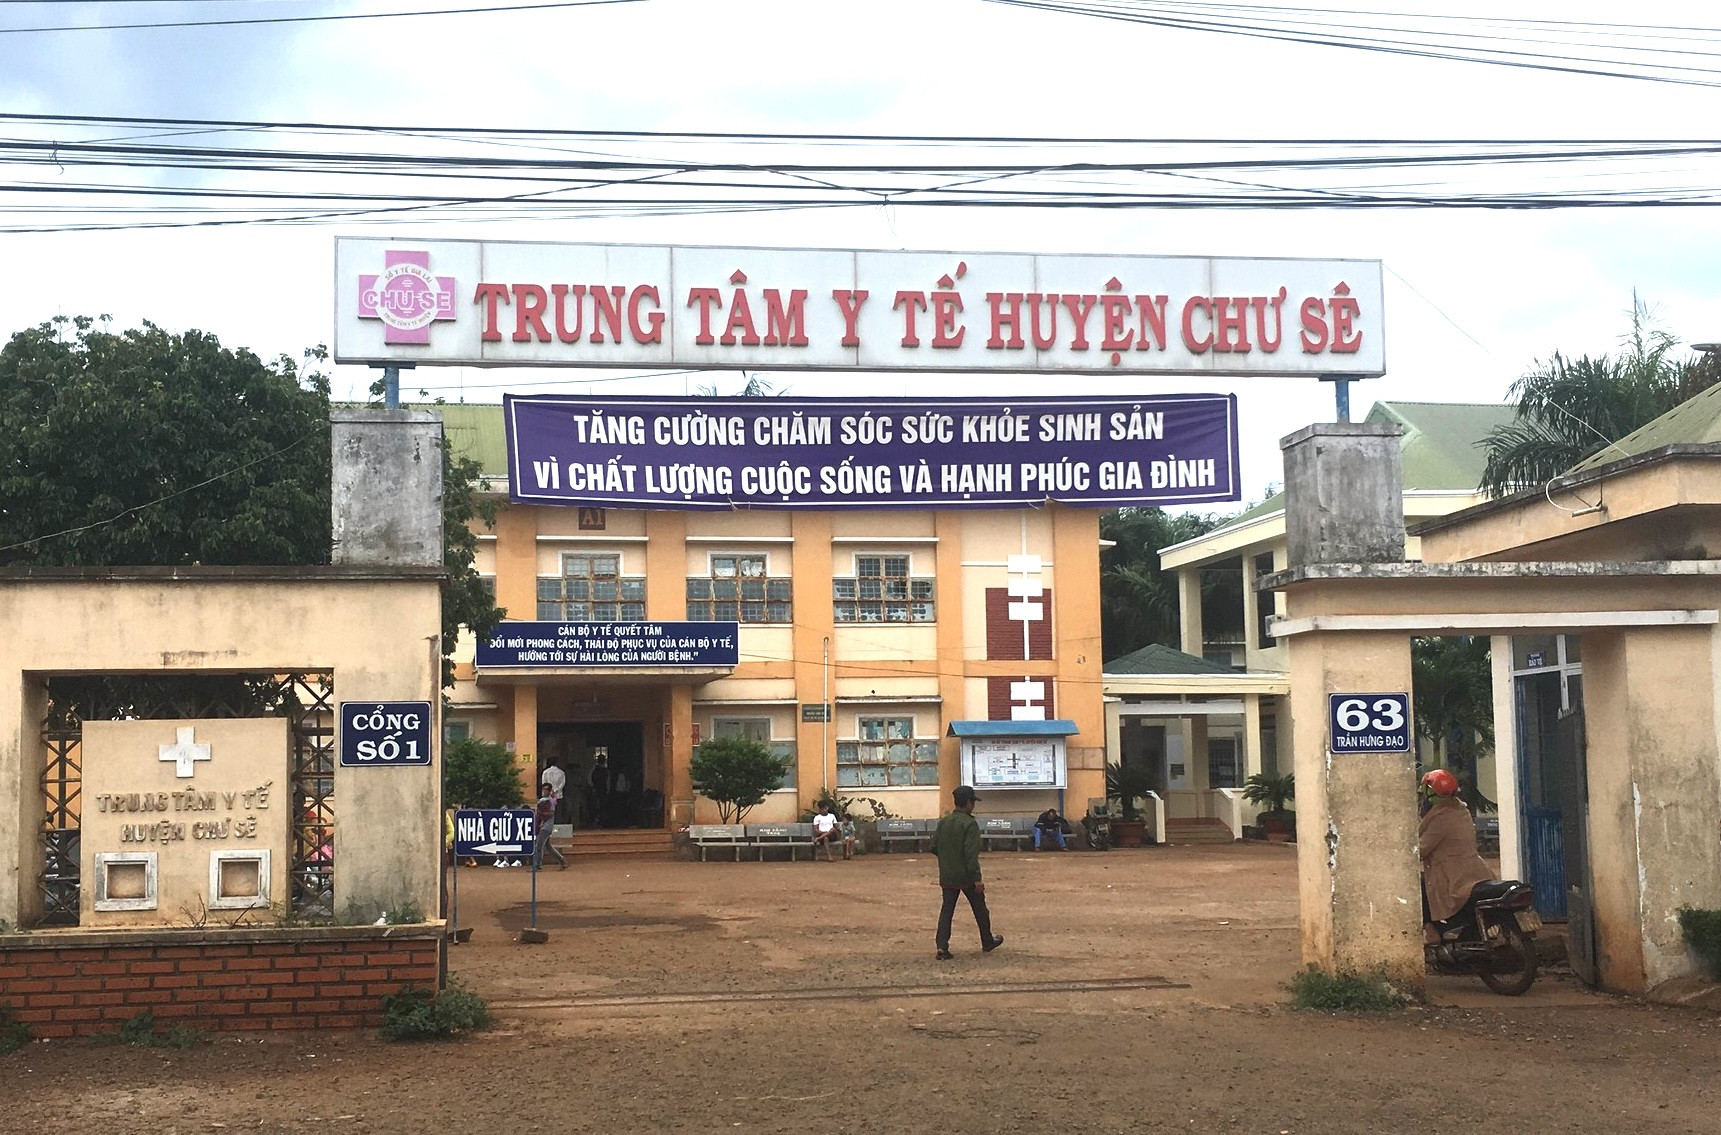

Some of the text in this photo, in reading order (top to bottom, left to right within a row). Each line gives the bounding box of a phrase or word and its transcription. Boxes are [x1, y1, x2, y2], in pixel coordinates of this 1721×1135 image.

[473, 261, 1363, 366] TRUNG TÂM Y TẾ HUYỆN CHƯ SÊ
[573, 404, 1164, 447] TĂNG CƯỜNG CHĂM SÓC SỨC KHỎE SINH SẢN
[533, 454, 1216, 501] VÌ CHẤT LƯỢNG CUỘC SỐNG VÀ HẠNH PHÚC GIA ĐÌNH
[507, 635, 524, 649] MỚI
[526, 638, 555, 649] PHONG
[556, 636, 583, 650] CÁCH,
[584, 636, 605, 649] THÁI
[606, 637, 619, 650] ĐỘ
[621, 638, 645, 650] PHỤC
[645, 638, 657, 650] VỤ
[659, 635, 677, 649] CỦA
[678, 636, 696, 648] CÁN
[697, 636, 710, 650] BỘ
[711, 638, 718, 648] Y
[558, 623, 662, 637] CÁN BỘ Y TẾ QUYẾT TÂM
[549, 649, 564, 661] TỚI
[565, 651, 578, 663] SỰ
[580, 650, 595, 661] HÀI
[596, 650, 620, 661] LÒNG
[621, 648, 639, 661] CỦA
[640, 649, 666, 661] NGƯỜI
[352, 704, 421, 731] CỔNG
[1336, 698, 1405, 732] 63
[356, 731, 421, 761] SỐ 1
[1359, 734, 1384, 747] HƯNG
[1385, 735, 1404, 748] ĐẠO
[96, 781, 273, 813] TRUNG TÂM Y TẾ
[121, 814, 258, 845] HUYỆN CHƯ SÊ
[458, 811, 485, 842] NHÀ
[489, 812, 513, 842] GIỮ
